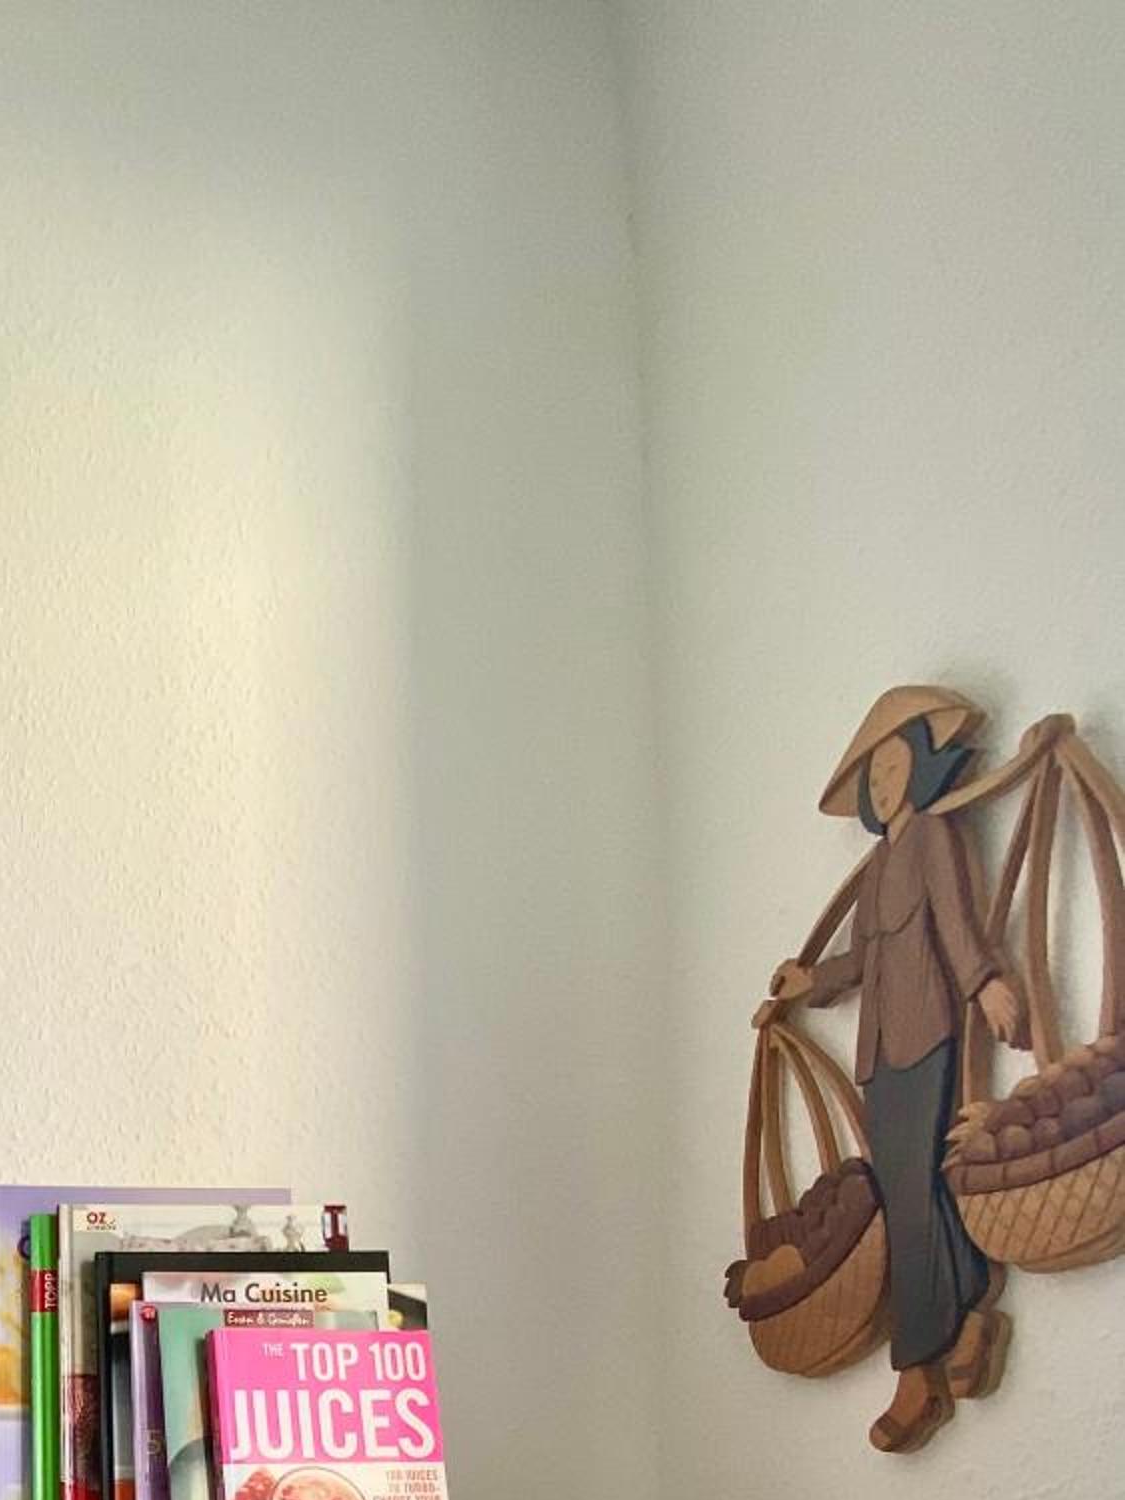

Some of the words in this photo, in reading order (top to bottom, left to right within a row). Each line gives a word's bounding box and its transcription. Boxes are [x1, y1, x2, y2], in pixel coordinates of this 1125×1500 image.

[44, 1273, 56, 1309] TOPP
[200, 1282, 236, 1303] Ma
[244, 1282, 328, 1303] Cuisine
[262, 1344, 284, 1357] THE
[291, 1342, 358, 1381] TOP
[369, 1341, 426, 1381] 100
[230, 1387, 435, 1460] JUICES
